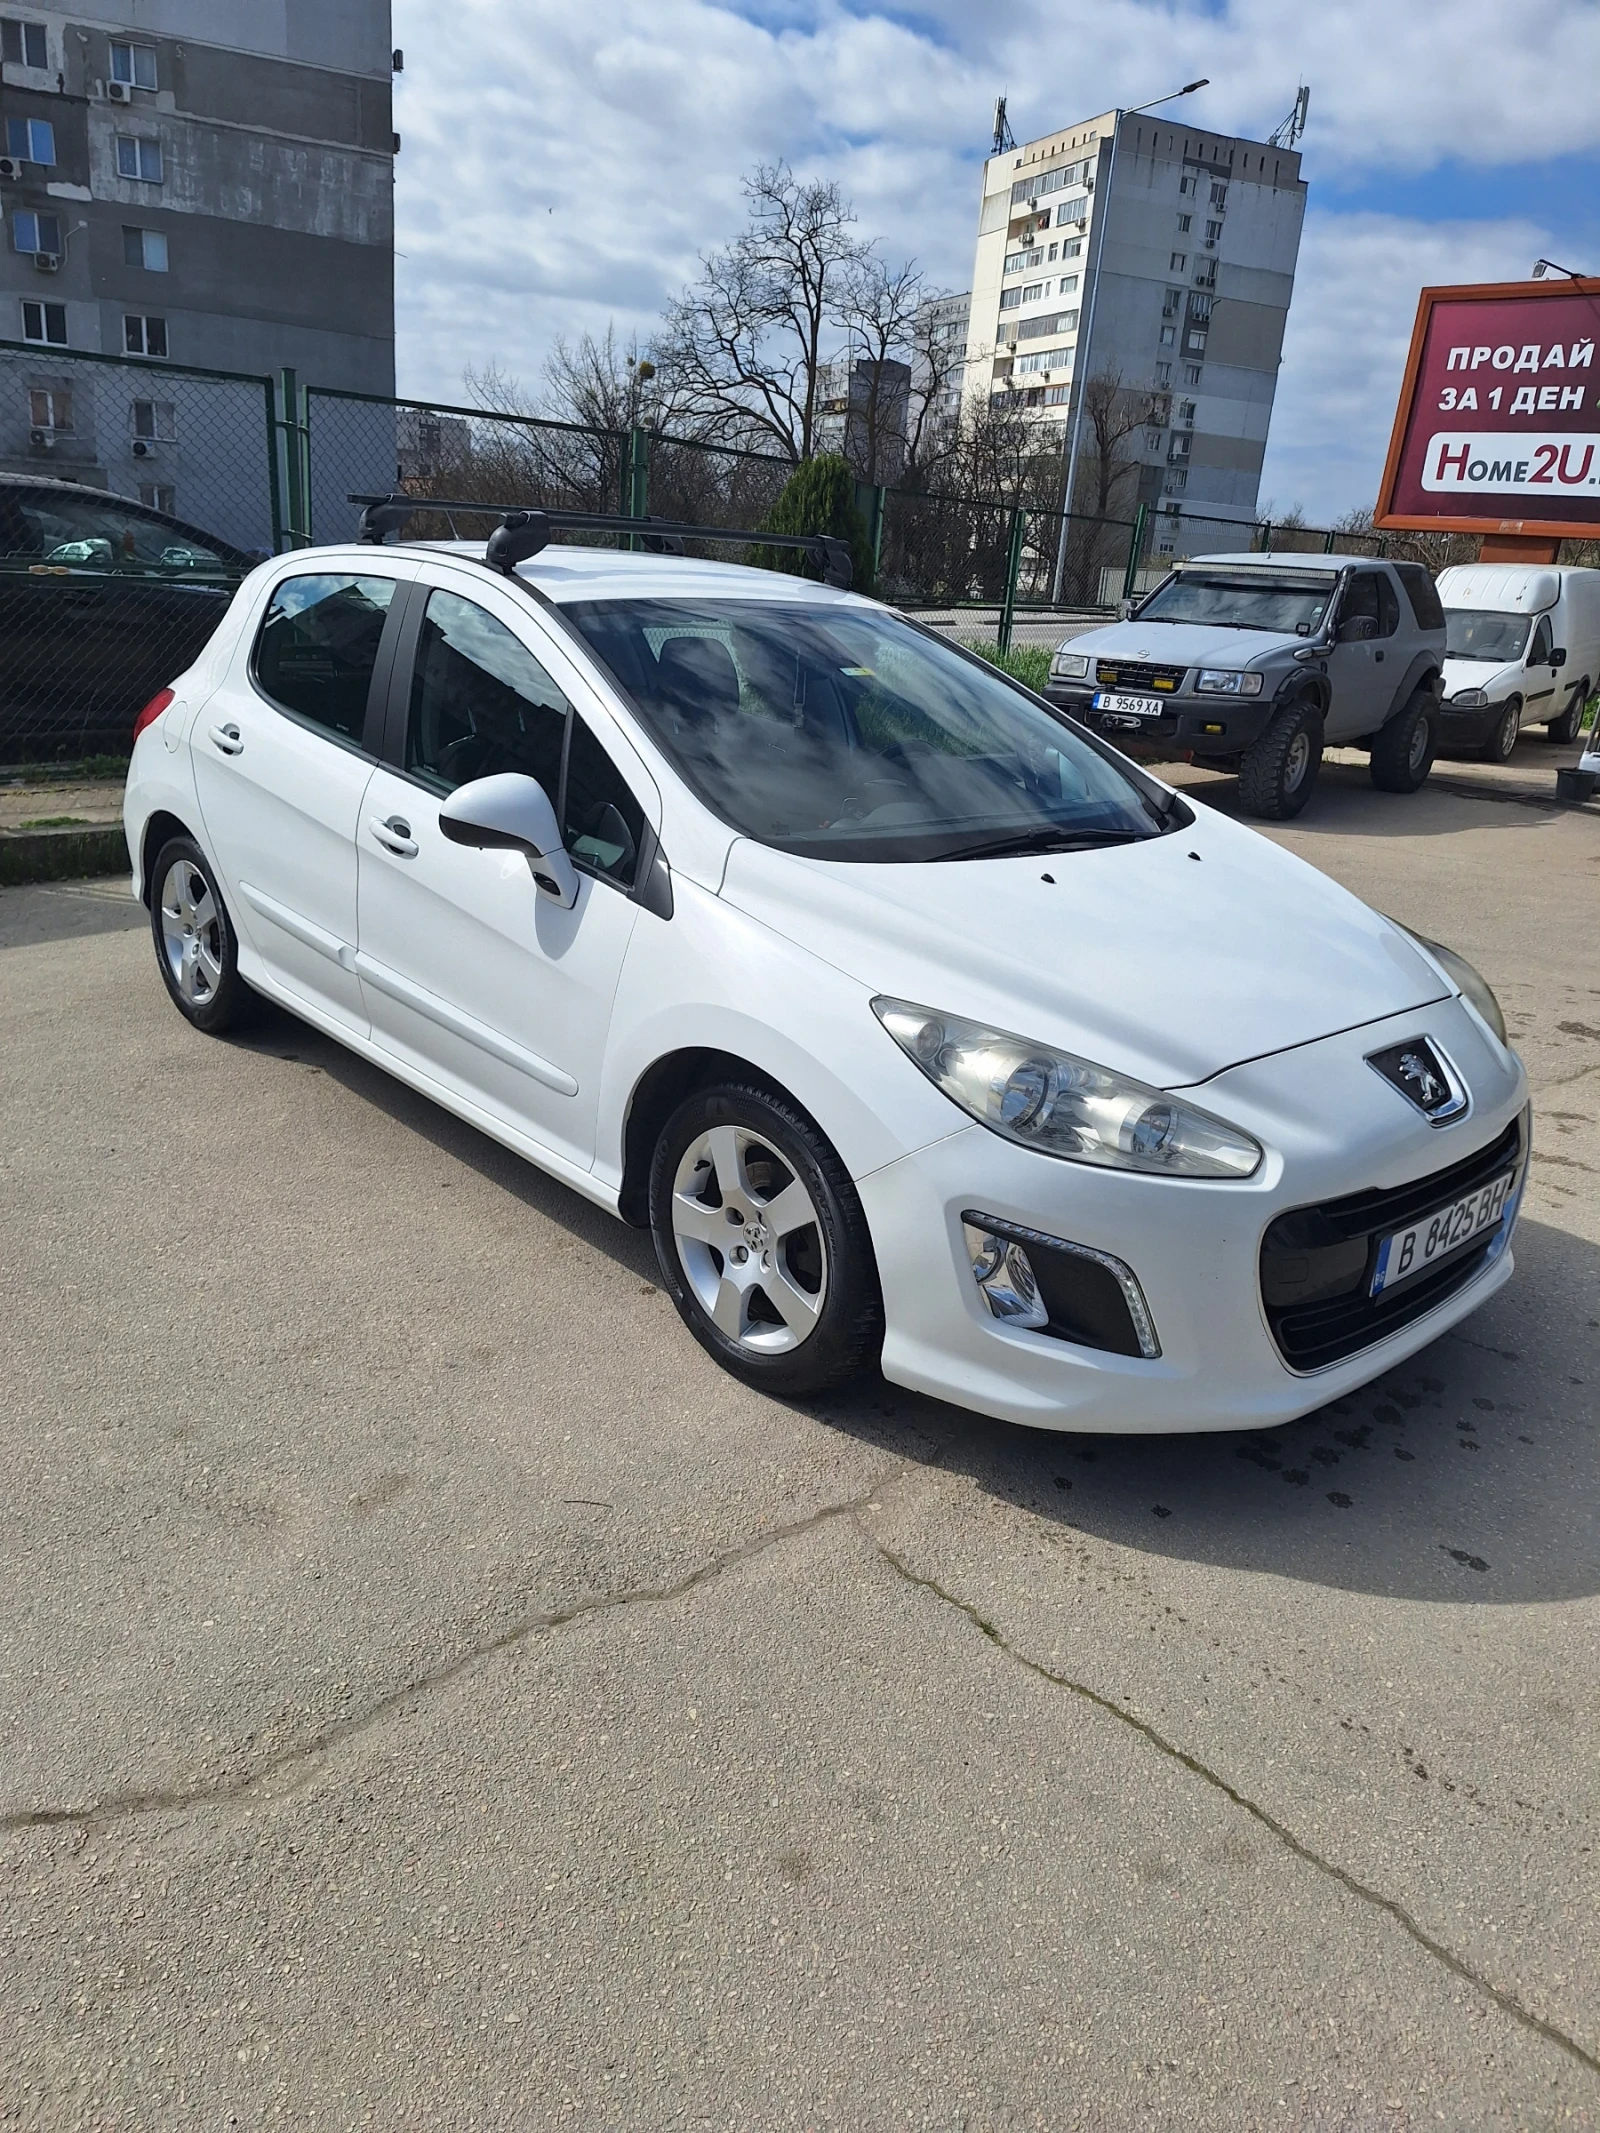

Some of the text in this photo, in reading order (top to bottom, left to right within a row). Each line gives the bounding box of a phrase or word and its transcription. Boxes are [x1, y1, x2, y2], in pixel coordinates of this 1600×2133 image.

[1446, 337, 1595, 374] ПРОДАЙ
[1438, 386, 1585, 415] ЗА 1 ДЕН
[1435, 443, 1600, 485] HOME2U.
[1103, 696, 1111, 708] B
[1398, 1178, 1508, 1275] B 8425 BH
